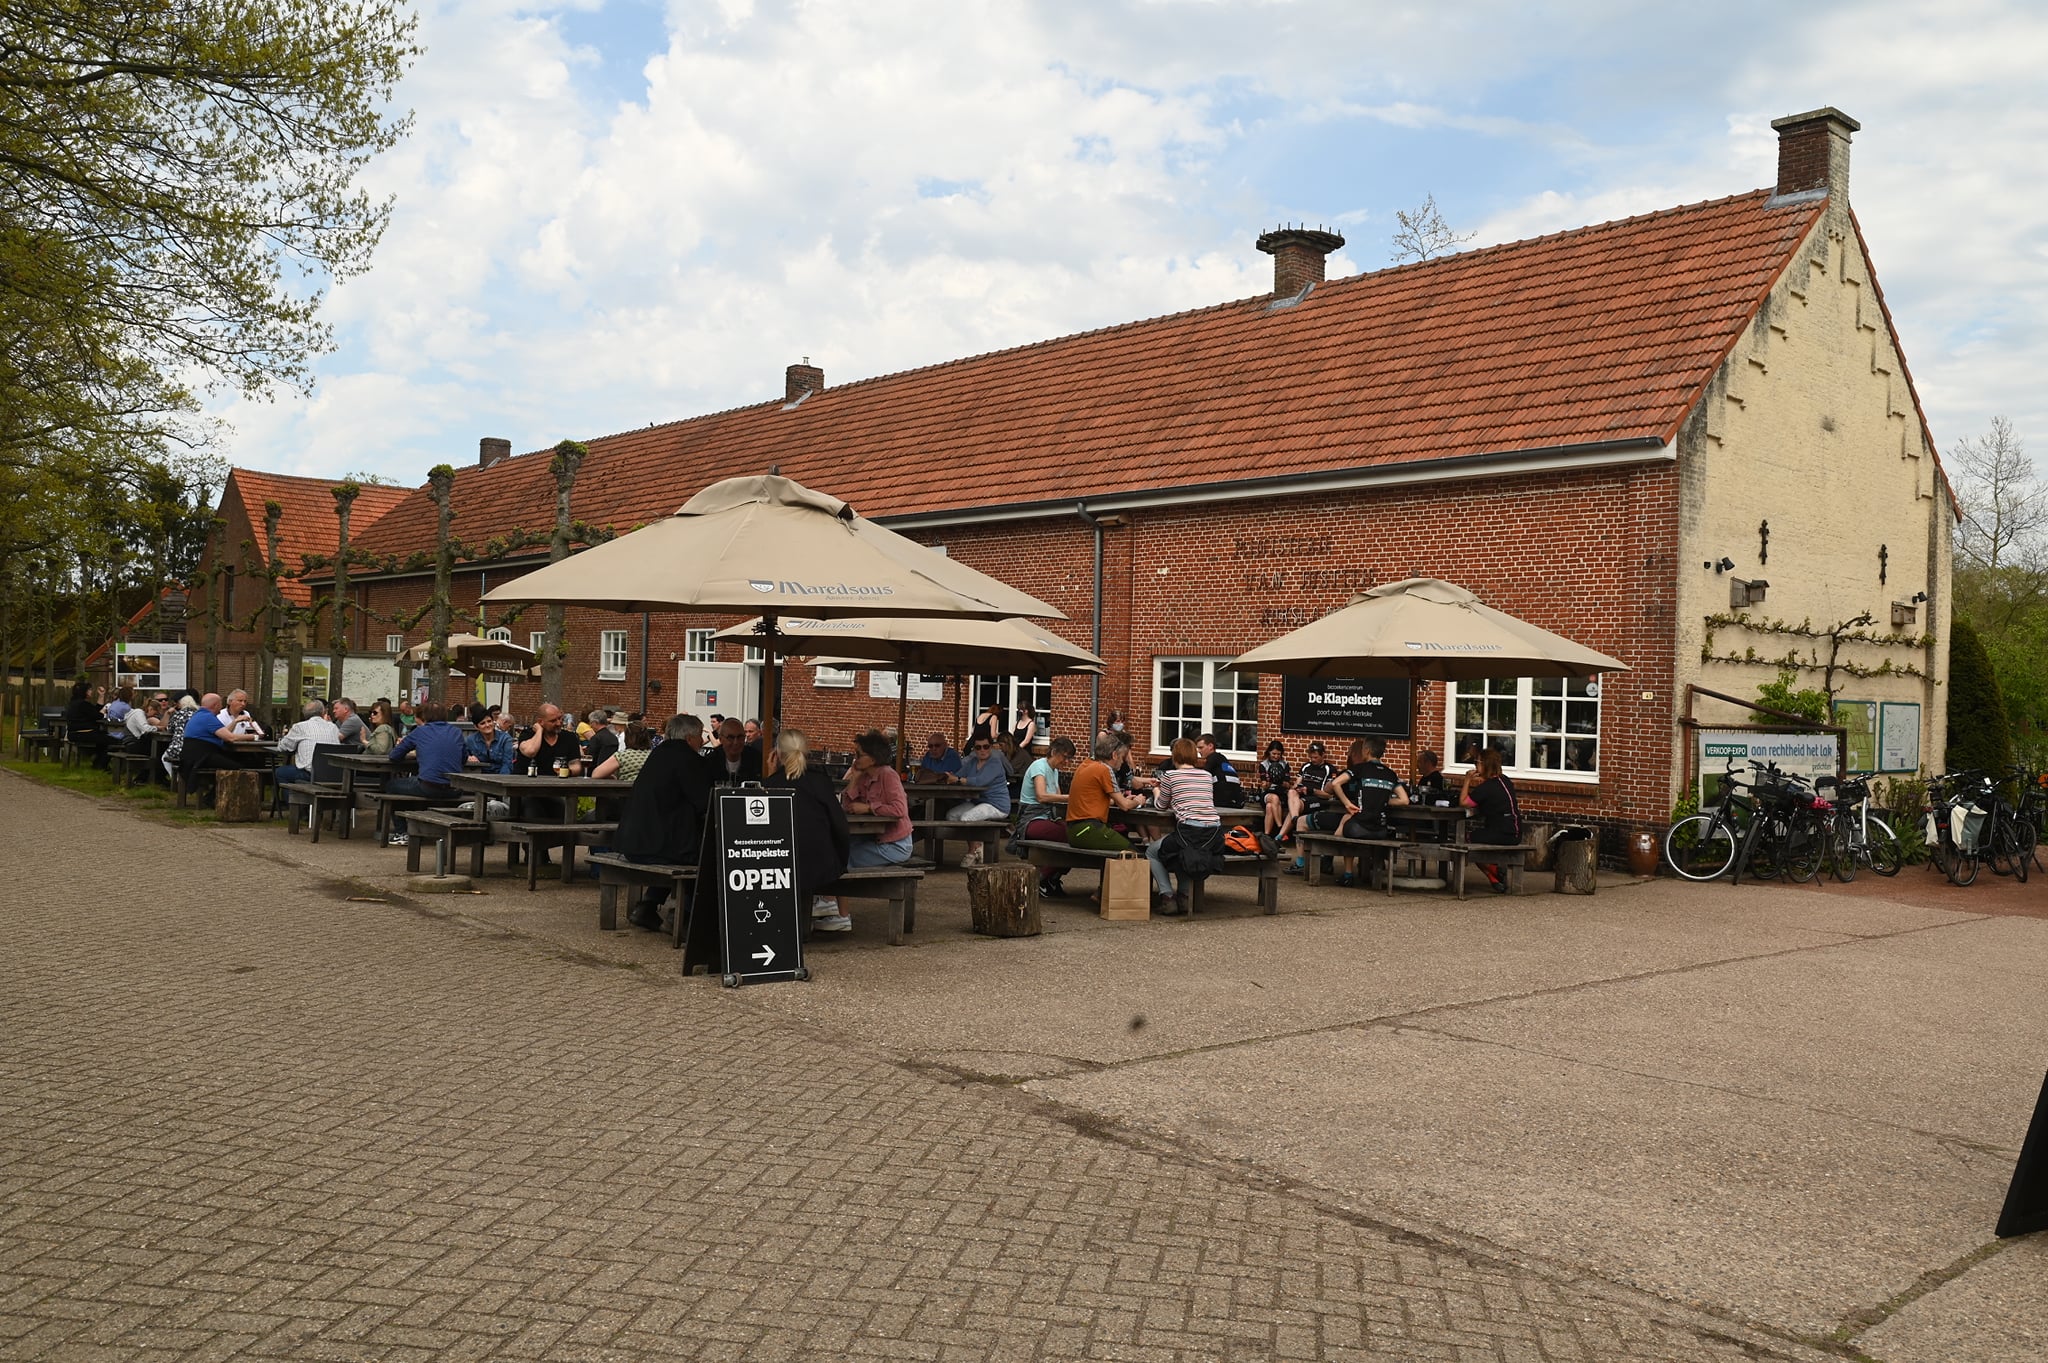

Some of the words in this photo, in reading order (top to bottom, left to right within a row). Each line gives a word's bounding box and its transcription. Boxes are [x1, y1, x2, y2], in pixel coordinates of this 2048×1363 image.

[779, 581, 894, 596] Maredsous
[799, 620, 865, 629] Maredsous
[1424, 642, 1502, 651] Maredsous
[1308, 692, 1322, 703] De
[1323, 692, 1383, 707] Klapekster
[1706, 746, 1746, 755] VERKOOP-EXPO
[1751, 746, 1768, 756] aan
[1768, 744, 1804, 757] rechtheid
[1806, 744, 1819, 757] het
[1820, 745, 1832, 757] lak
[728, 848, 741, 858] De
[741, 848, 790, 860] Klapekster
[729, 868, 791, 892] OPEN
